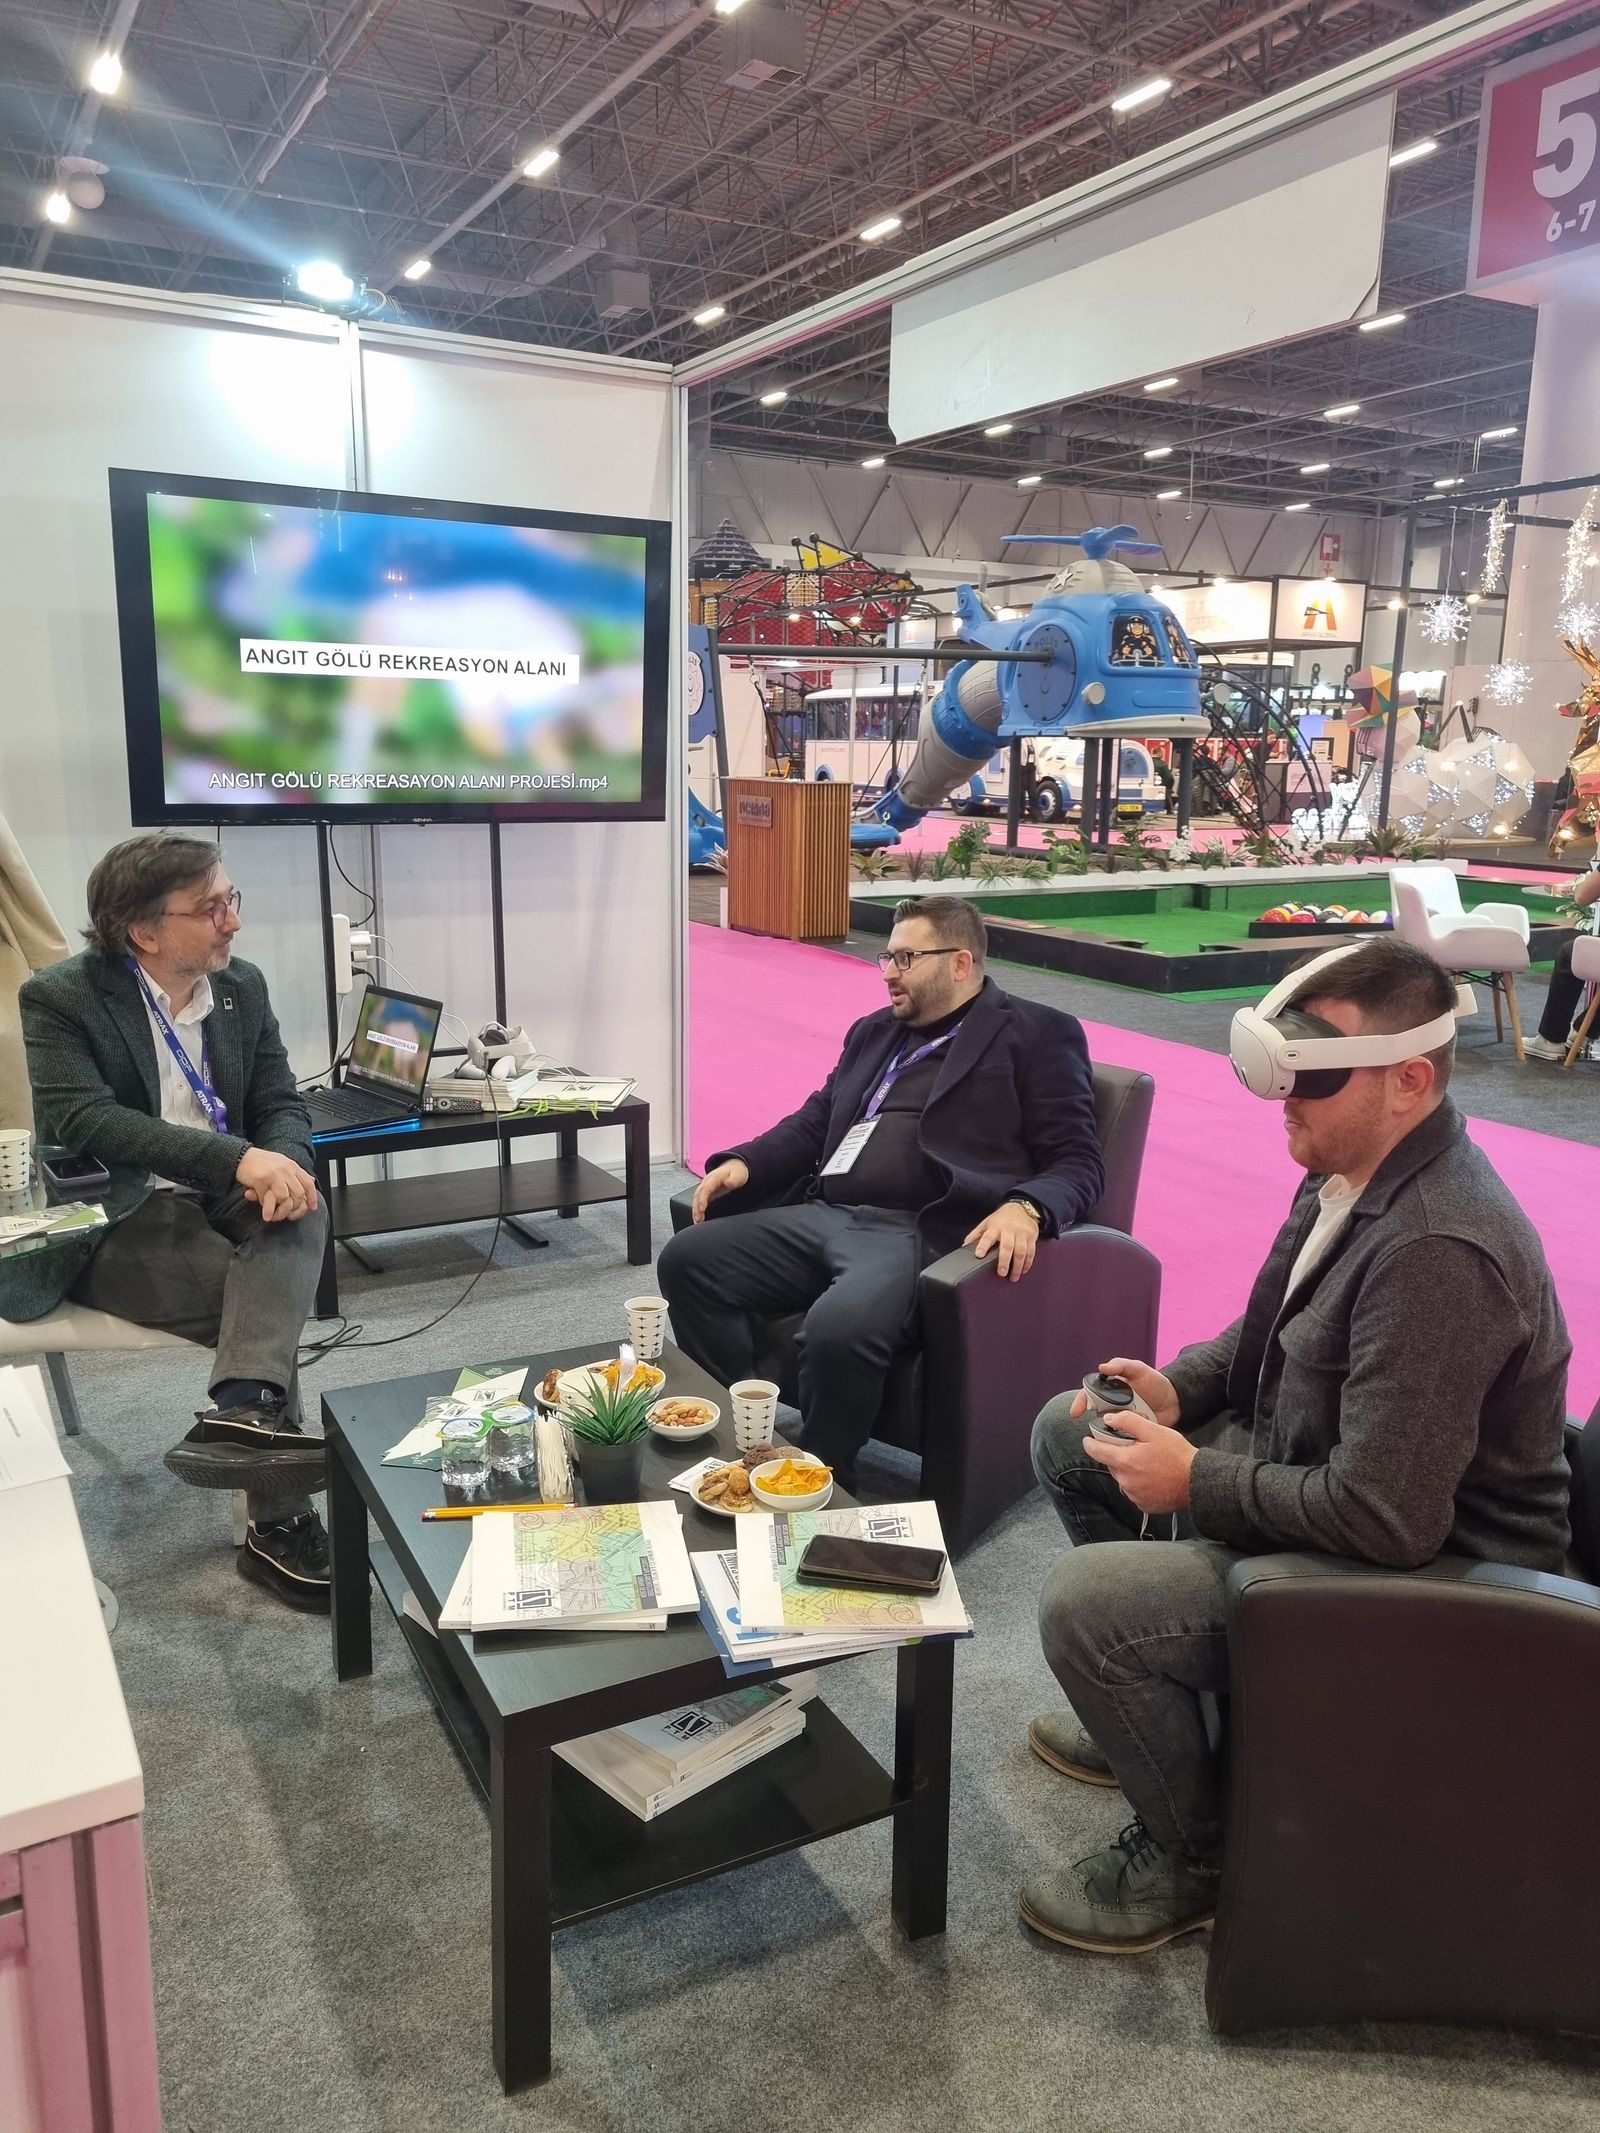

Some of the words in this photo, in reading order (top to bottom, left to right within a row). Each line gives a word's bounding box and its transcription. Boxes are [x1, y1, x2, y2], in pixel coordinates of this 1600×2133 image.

[1533, 68, 1600, 198] 5
[1546, 200, 1597, 242] 6-7
[245, 648, 309, 666] ANGIT
[316, 649, 371, 668] GÖLÜ
[379, 654, 508, 674] REKREASYON
[513, 660, 566, 676] ALANI
[208, 773, 267, 788] ANGIT
[271, 771, 322, 788] GÖLÜ
[328, 773, 456, 789] REKREASAYON
[458, 774, 505, 789] ALANI
[510, 772, 609, 791] PROJESİ.mp4
[152, 1010, 169, 1036] ATRAX
[195, 1090, 214, 1114] ATRAX
[877, 1081, 891, 1100] ATRAX
[663, 1724, 690, 1741] PTM
